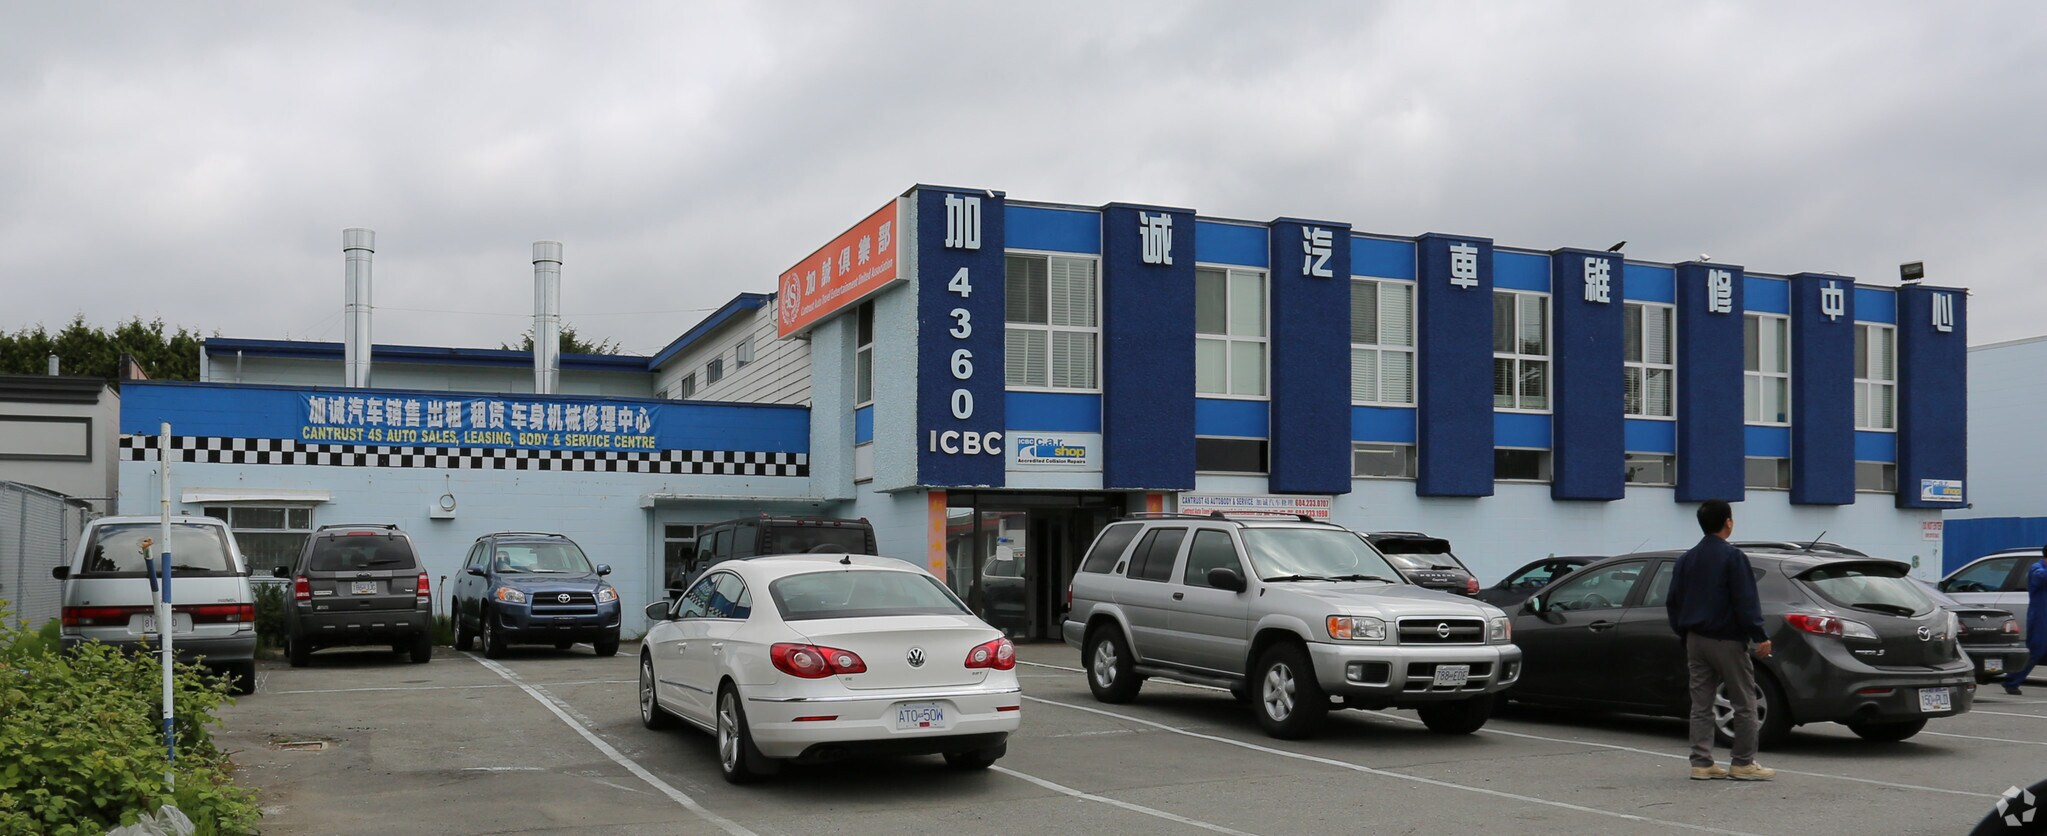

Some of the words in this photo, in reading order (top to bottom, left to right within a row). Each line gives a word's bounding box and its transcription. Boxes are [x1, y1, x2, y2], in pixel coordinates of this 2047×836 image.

[948, 266, 974, 420] 4360
[427, 400, 462, 428] 出租
[470, 401, 505, 429] 租赁
[511, 402, 651, 434] 车身机械修理中心
[302, 426, 364, 441] CANTRUST
[368, 428, 382, 442] 4S
[387, 429, 417, 443] AUTO
[421, 430, 460, 446] SALES,
[464, 431, 514, 447] LEASING,
[519, 433, 549, 446] BODY
[553, 434, 560, 446] &
[565, 434, 610, 447] SERVICE
[614, 435, 655, 449] CENTRE
[930, 430, 1003, 455] ICBC
[1055, 446, 1085, 458] shop
